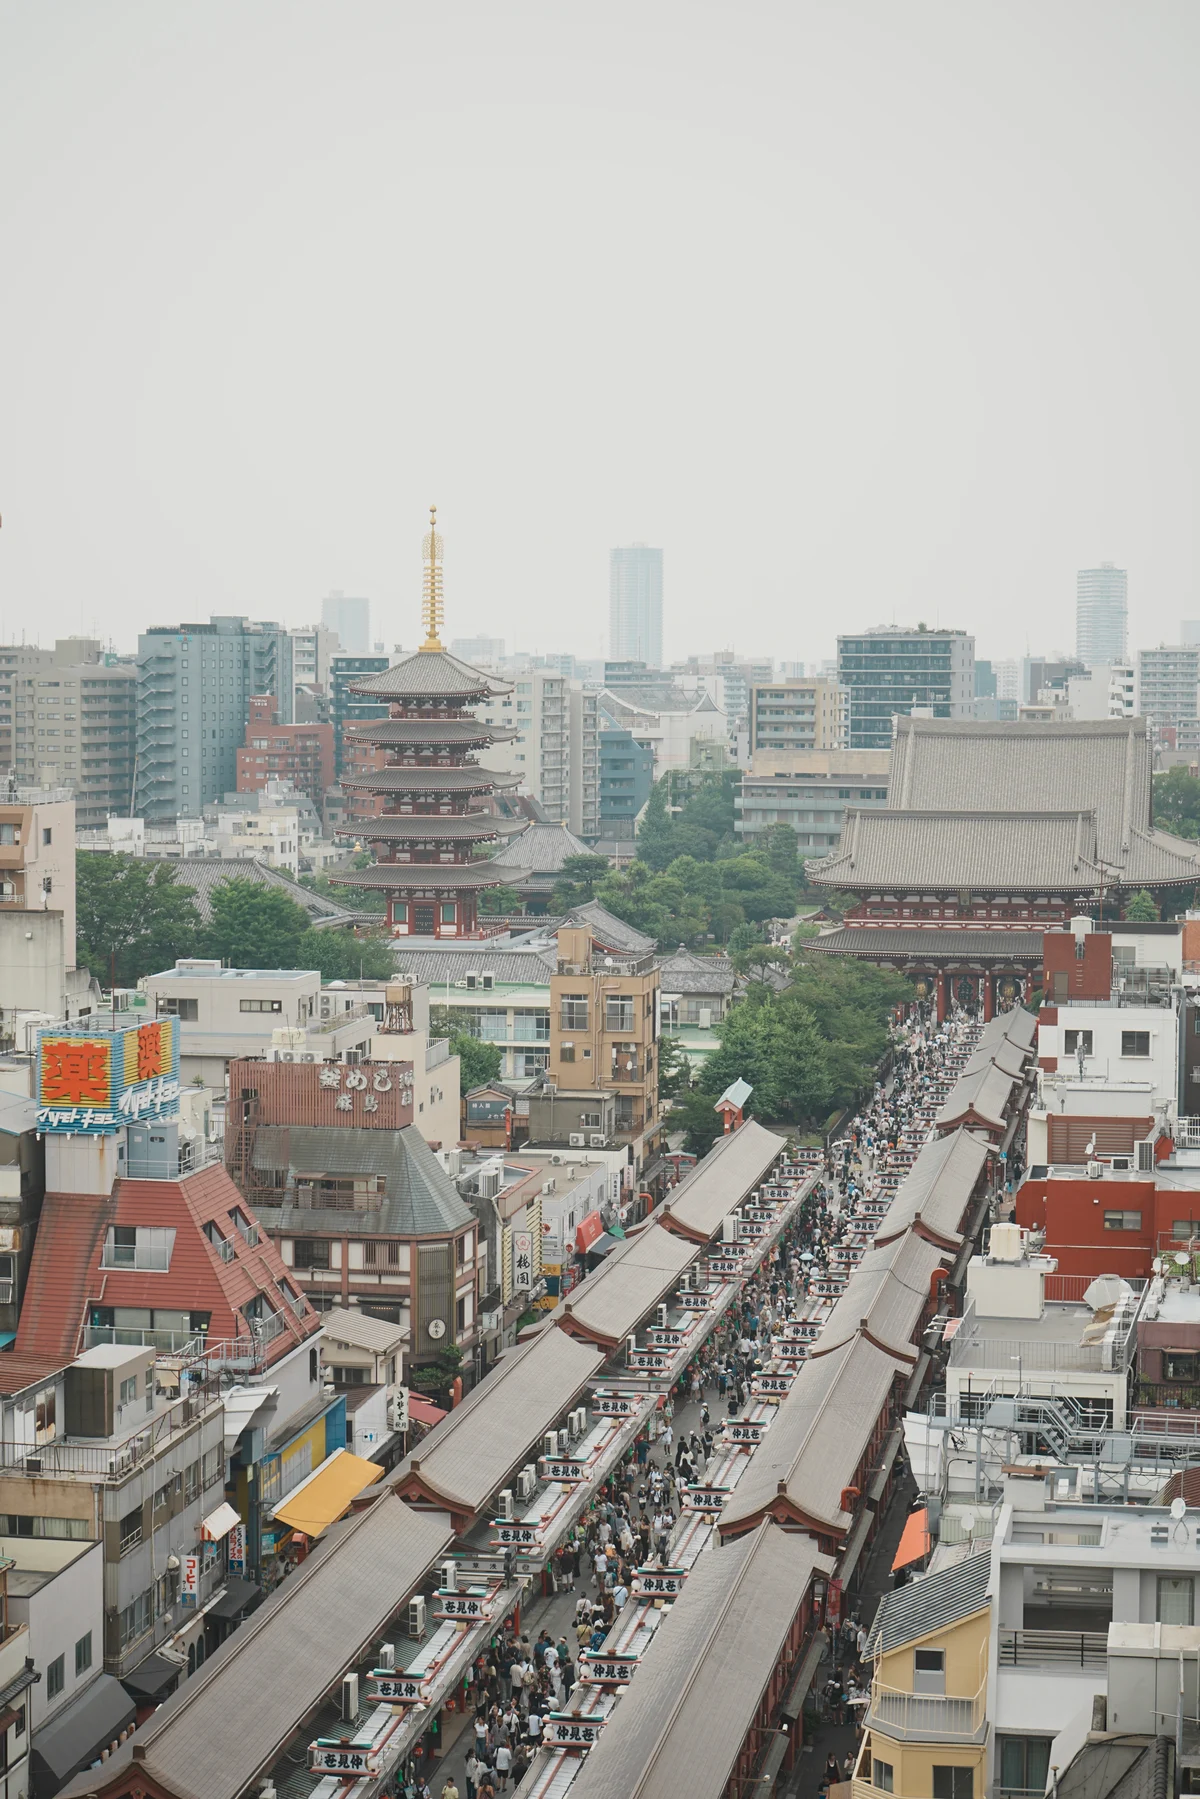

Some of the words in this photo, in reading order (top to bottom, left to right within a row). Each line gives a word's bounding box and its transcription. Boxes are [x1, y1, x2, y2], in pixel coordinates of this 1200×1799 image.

[137, 1022, 162, 1080] 薬
[43, 1042, 109, 1102] 薬
[118, 1078, 180, 1120] マツモトキヨシ
[35, 1107, 117, 1129] マツモトキヨシ
[732, 1428, 760, 1439] 仲見世
[693, 1494, 723, 1506] 仲見世
[186, 1559, 196, 1590] コーヒー
[643, 1579, 676, 1592] 仲見世
[593, 1664, 629, 1678] 仲見世
[557, 1726, 594, 1741] 仲見世
